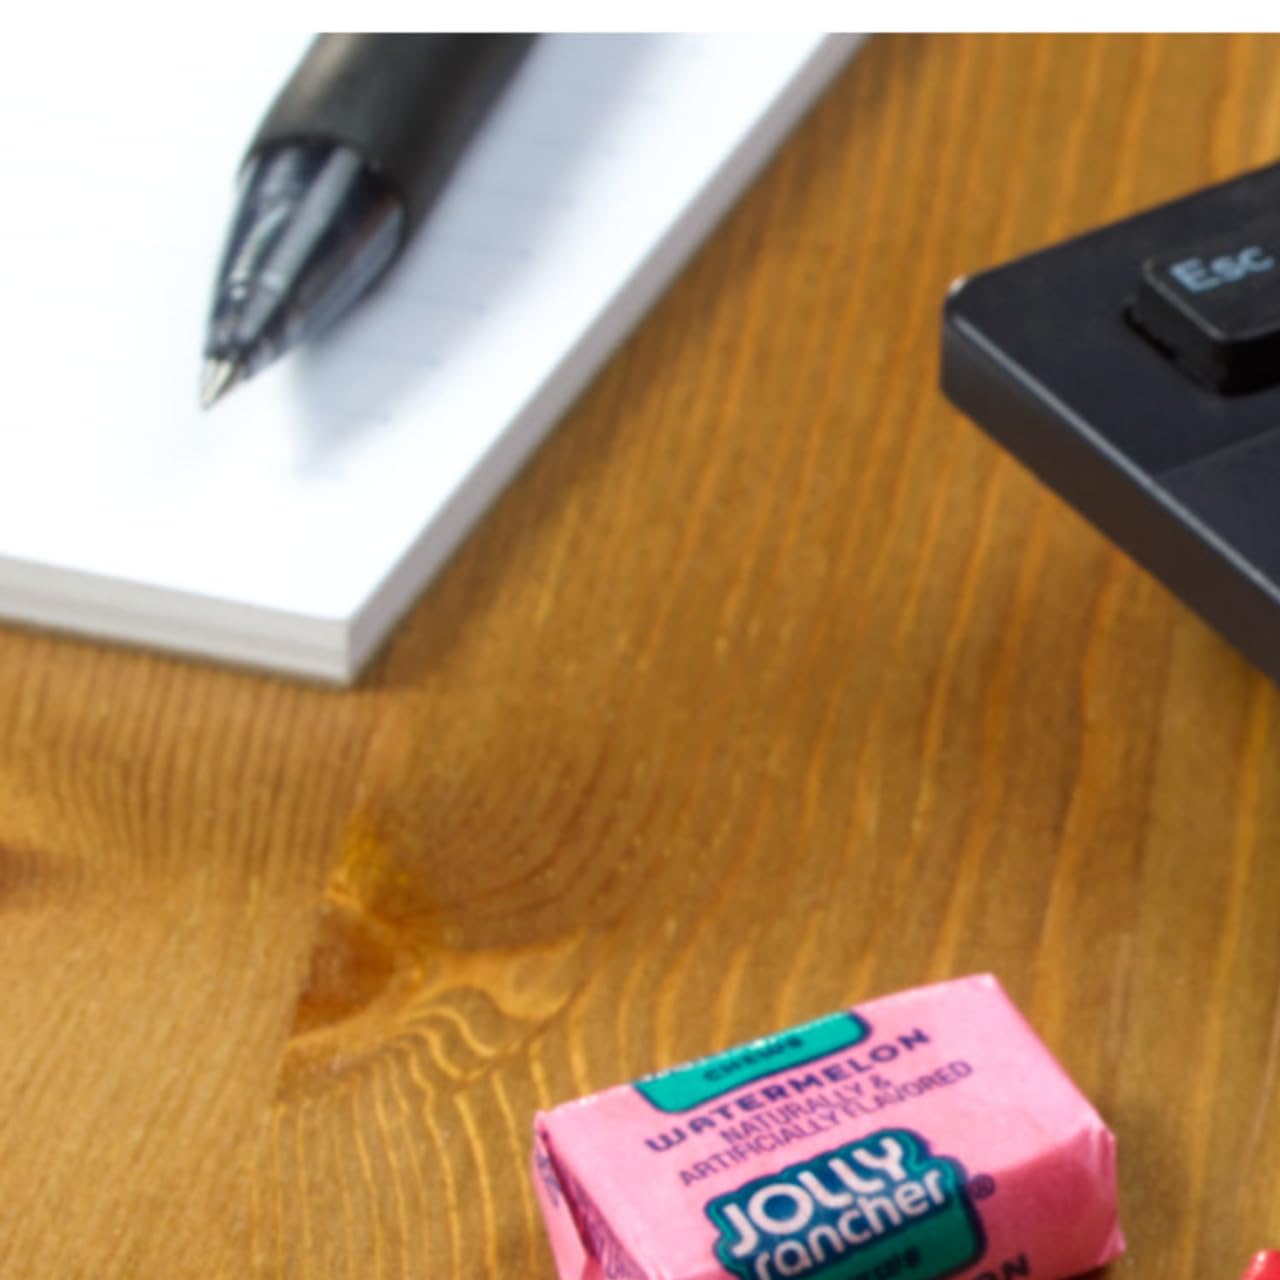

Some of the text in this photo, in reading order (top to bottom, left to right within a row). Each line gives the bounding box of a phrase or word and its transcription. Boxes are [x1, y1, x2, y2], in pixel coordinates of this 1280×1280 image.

[1169, 245, 1276, 294] Esc
[644, 1028, 931, 1152] WATERMELON
[678, 1059, 974, 1187] ARTIFICIALLY FLAVORED
[719, 1082, 862, 1145] NATURALLY
[722, 1137, 907, 1258] JOLLY
